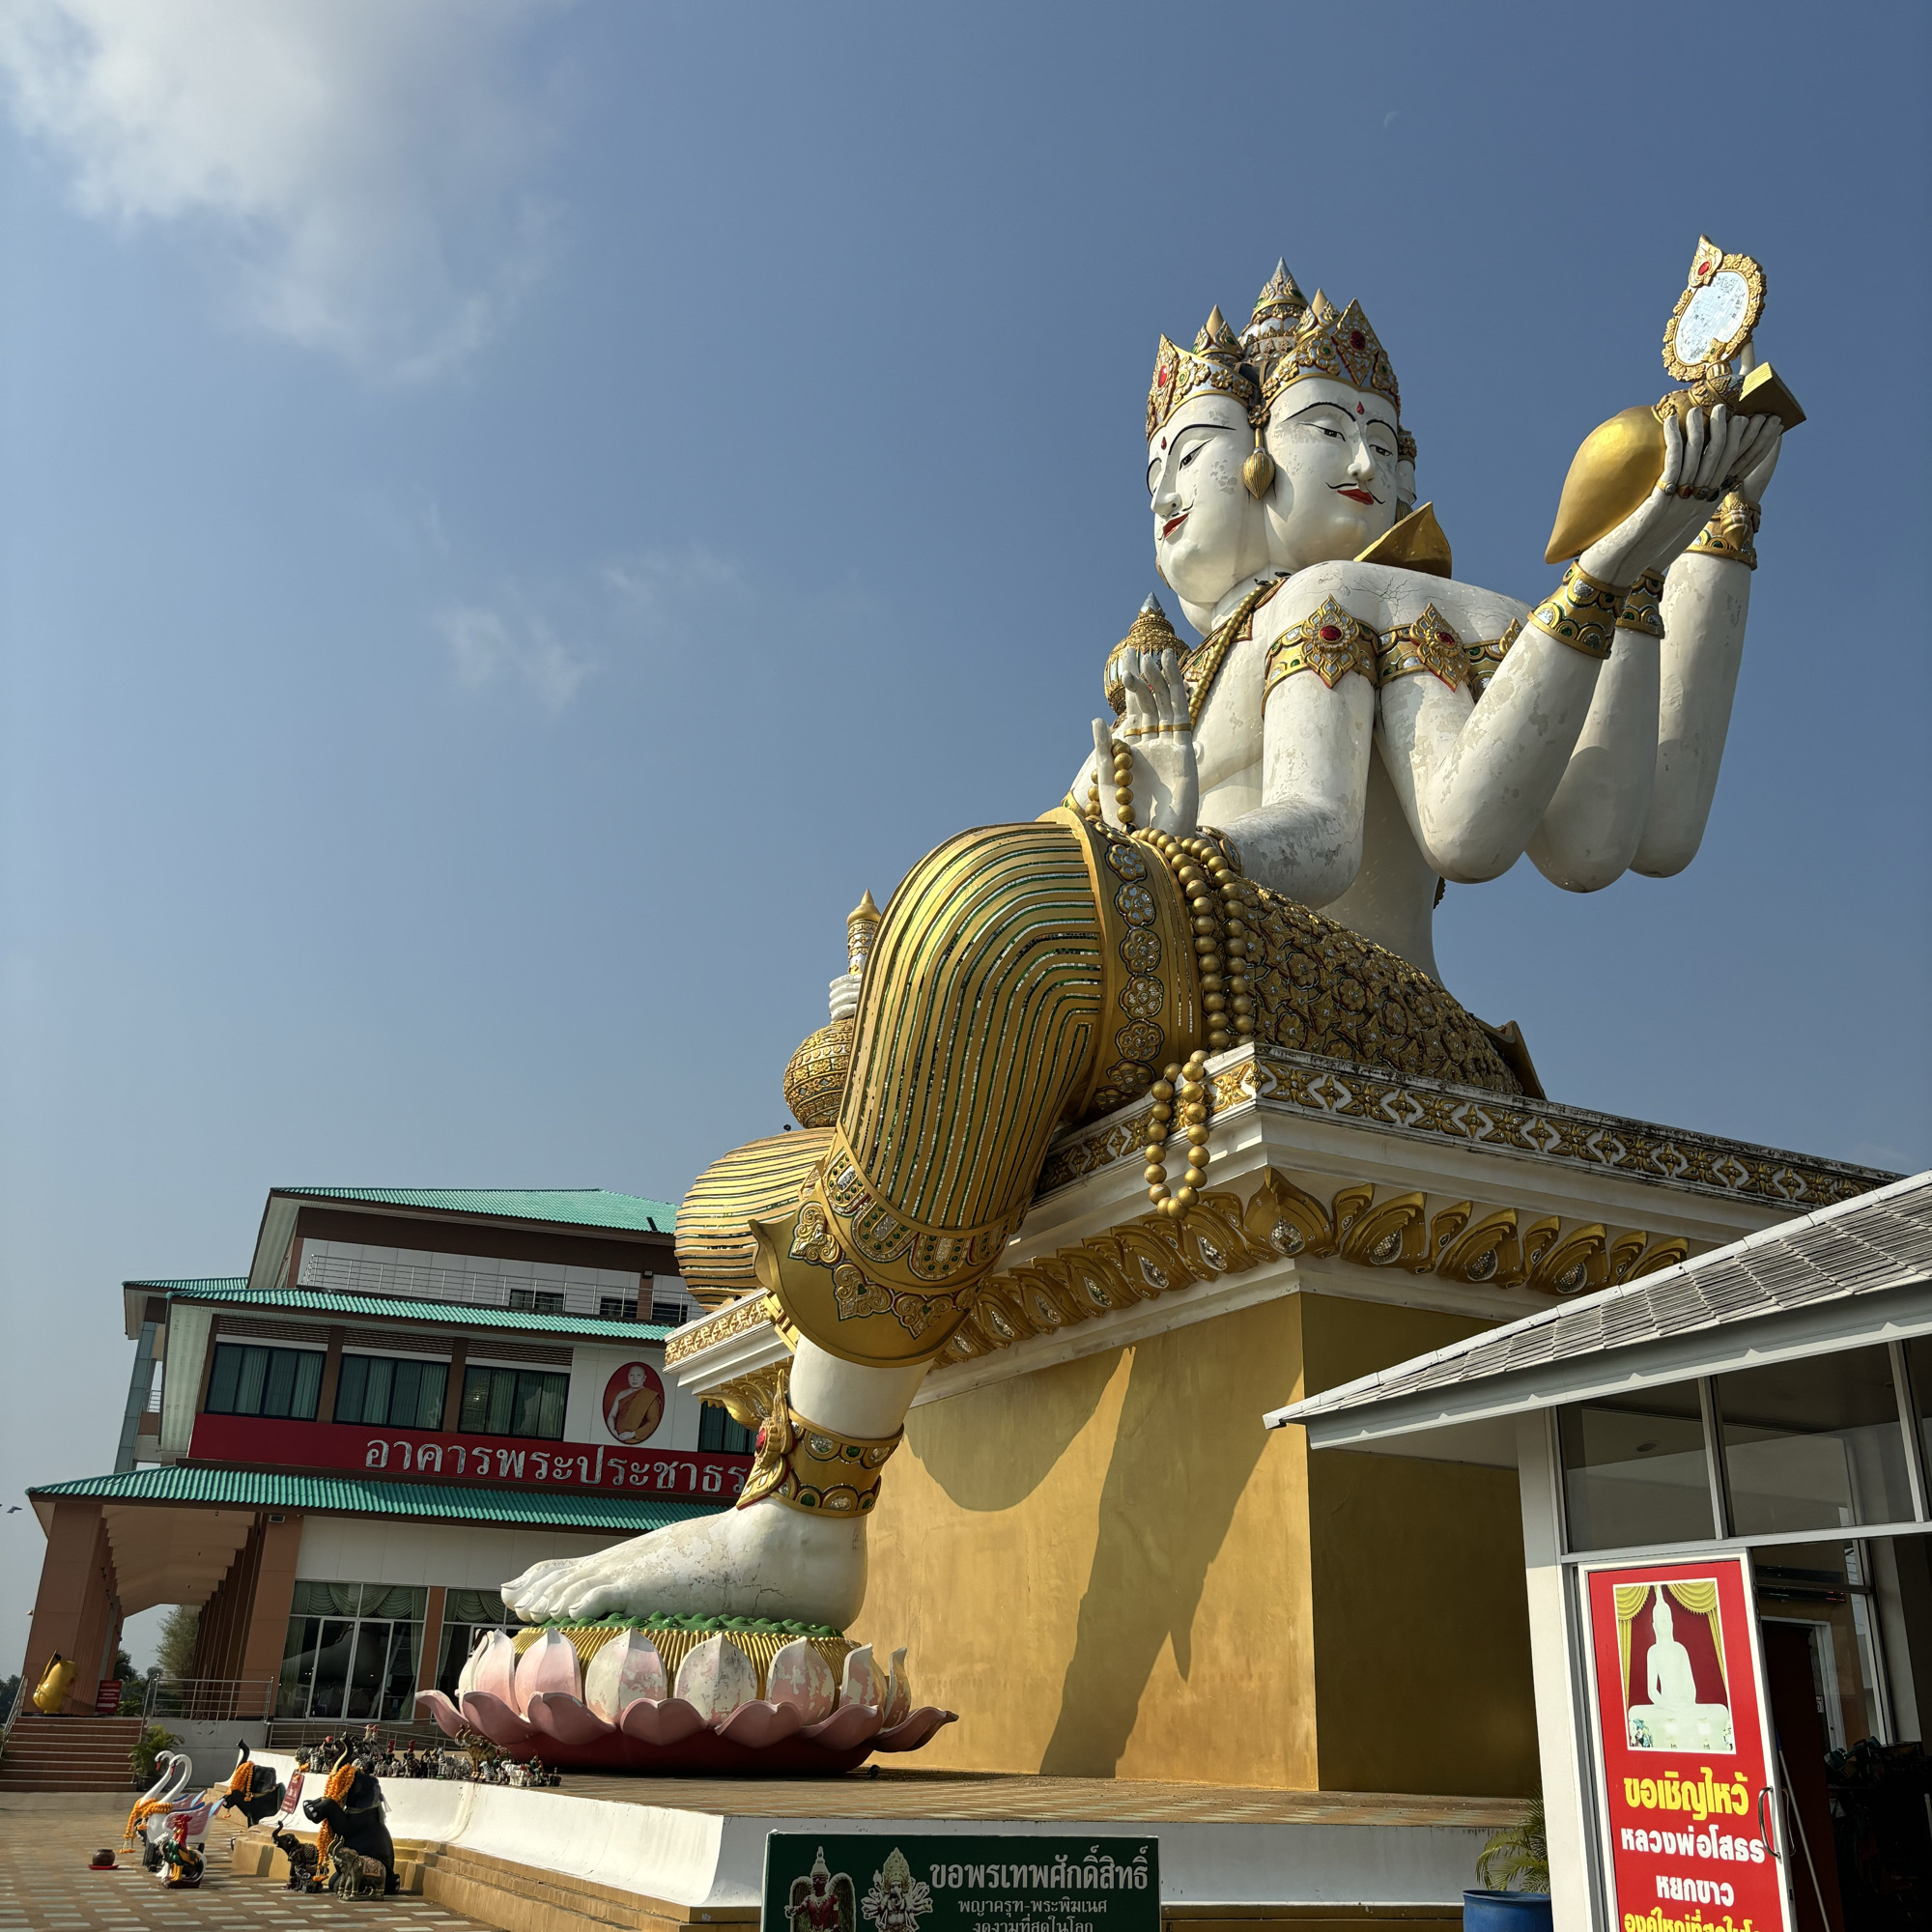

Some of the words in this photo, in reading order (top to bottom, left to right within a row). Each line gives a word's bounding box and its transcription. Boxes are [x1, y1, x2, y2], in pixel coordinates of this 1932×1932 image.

[1624, 1767, 1749, 1821] ขอเชิญไหว้
[1621, 1824, 1766, 1863] หลวงพ่อโสธร
[929, 1844, 1149, 1889] ขอพรเทพศักดิ์สิทธิ์
[1656, 1875, 1735, 1907] หยกขาว
